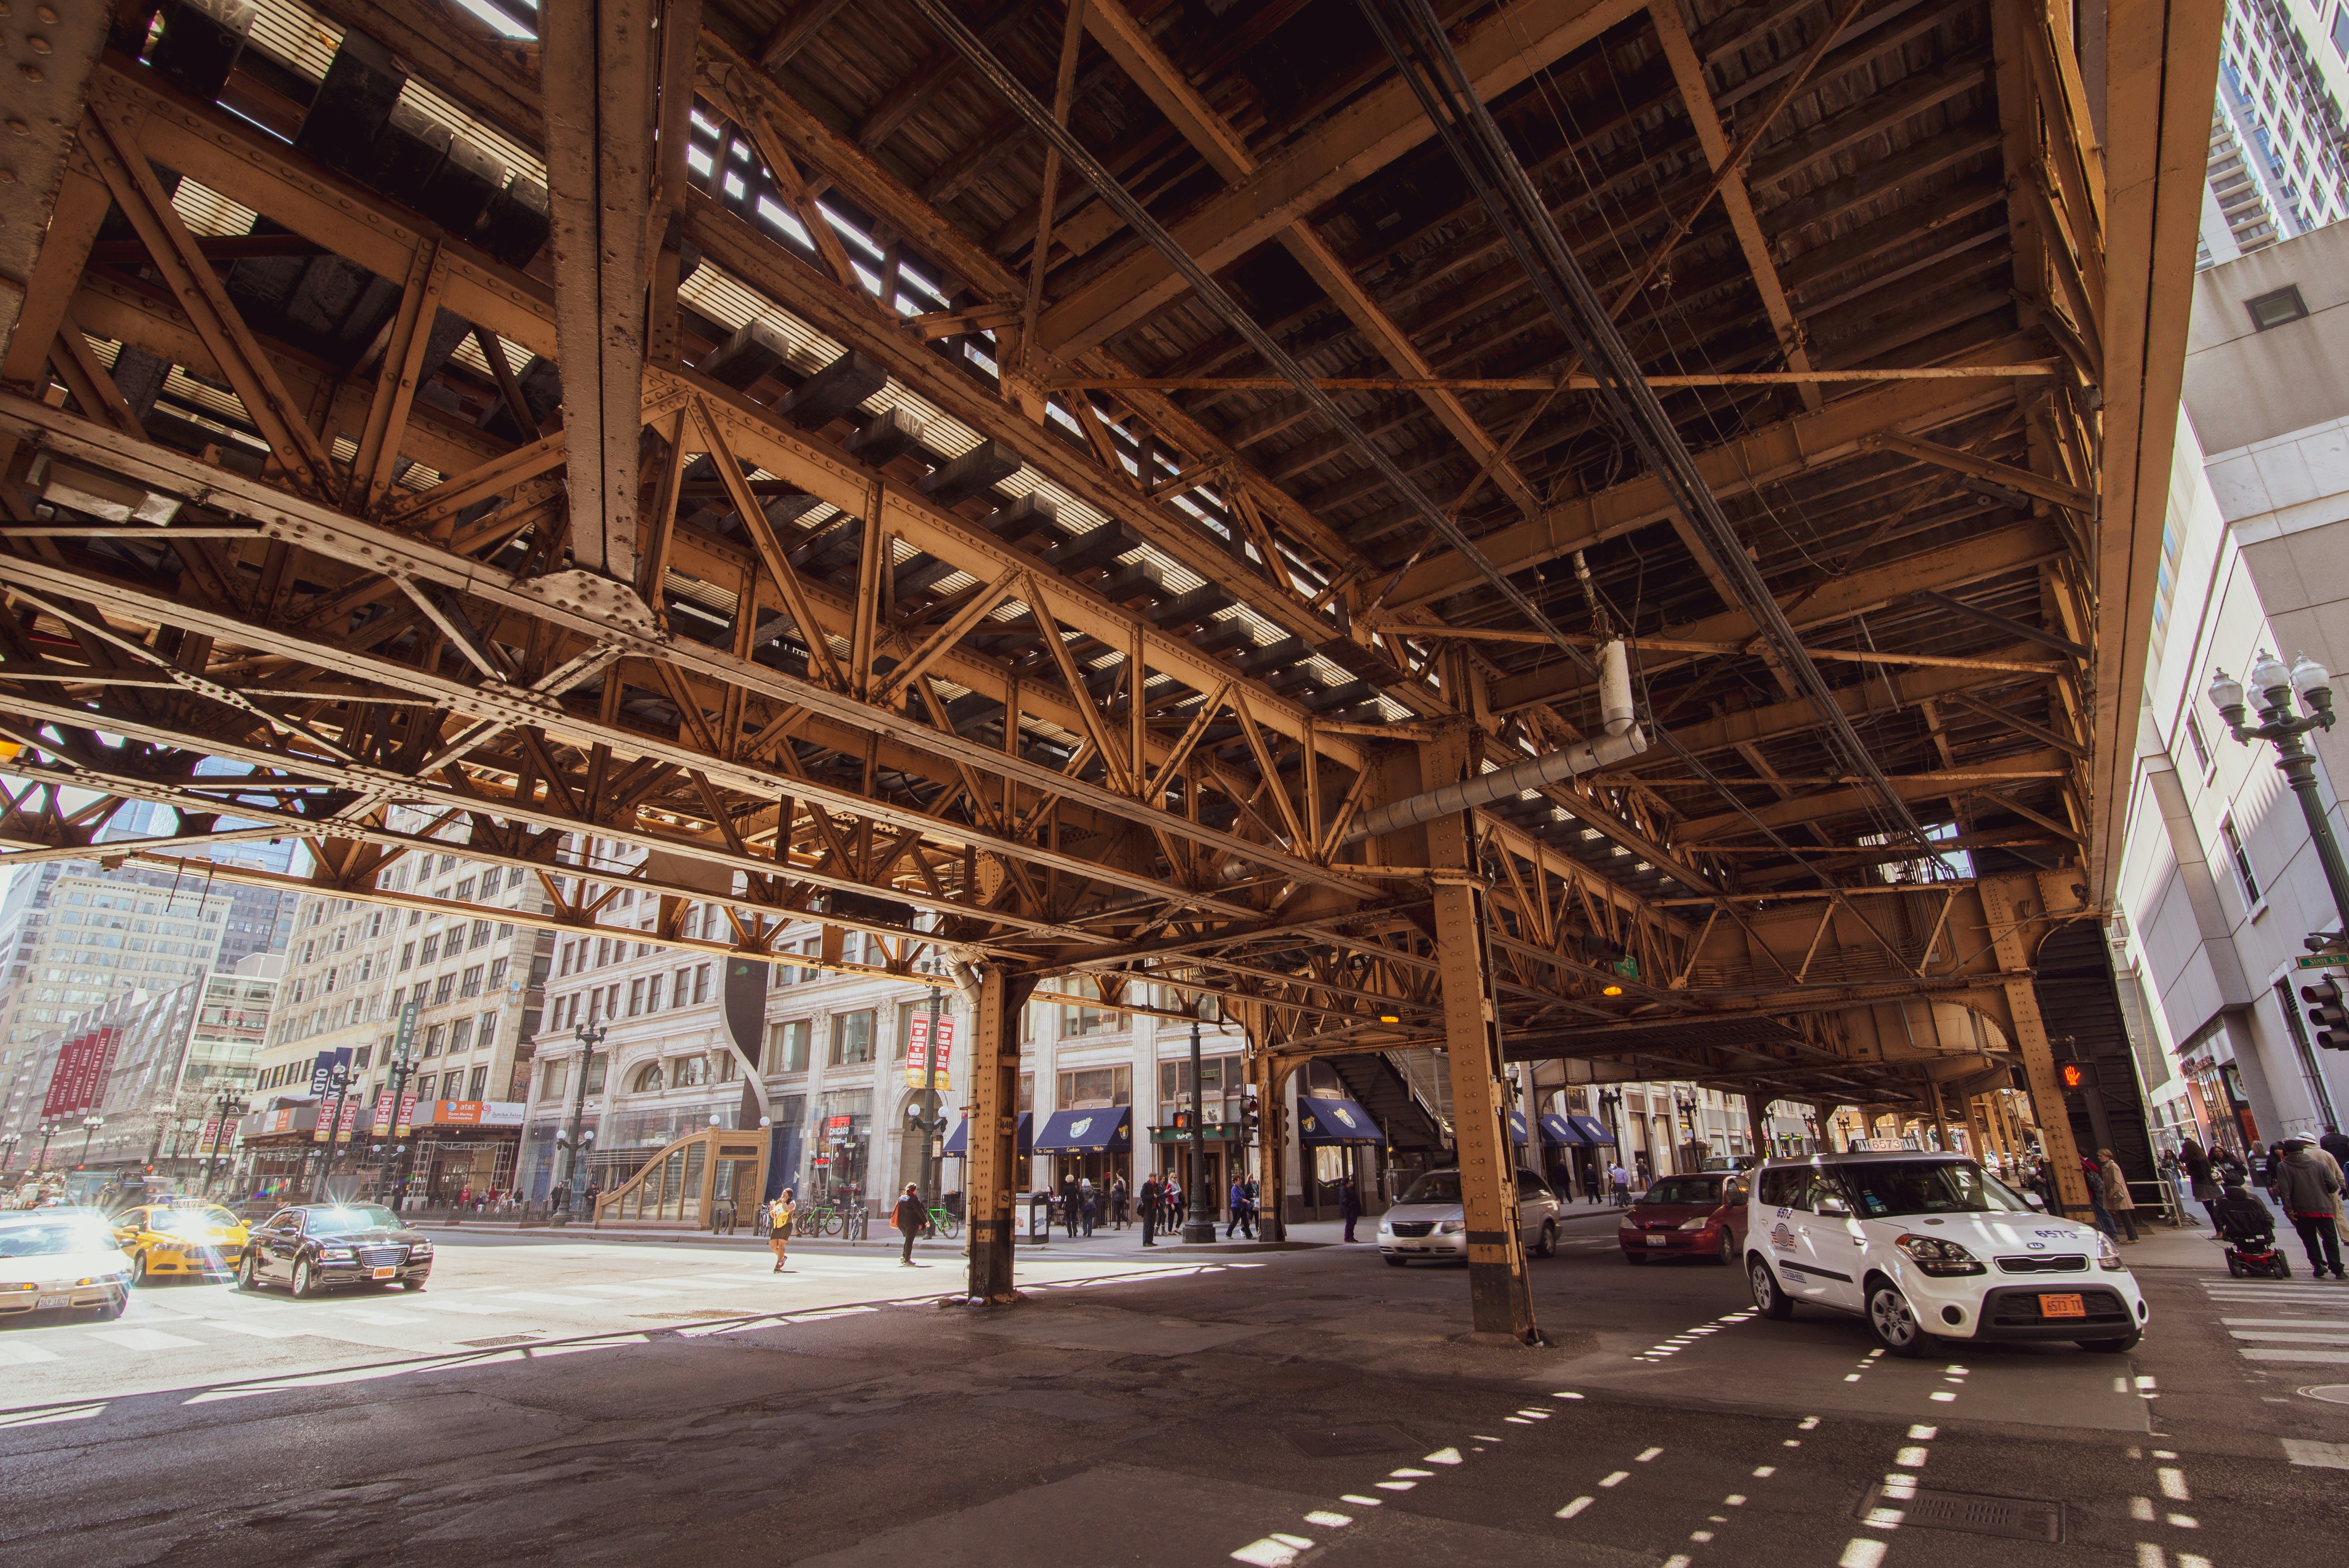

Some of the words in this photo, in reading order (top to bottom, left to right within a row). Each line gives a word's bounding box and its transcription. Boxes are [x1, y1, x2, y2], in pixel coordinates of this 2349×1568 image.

[403, 1008, 414, 1038] GENE
[84, 1081, 94, 1098] SHOPS
[98, 1037, 106, 1053] STATE
[394, 1042, 407, 1088] SISEL
[46, 1085, 57, 1108] SHOPPING
[56, 1059, 65, 1075] DINING
[58, 1089, 67, 1105] SHOPS
[71, 1048, 79, 1063] STATE
[70, 1076, 82, 1102] SHOPPING
[81, 1049, 90, 1066] DINING
[313, 1068, 328, 1092] OLD
[829, 1116, 850, 1127] ESPN
[1071, 1117, 1093, 1128] Potbelly
[829, 1127, 849, 1135] CHICAGO
[1856, 1140, 1873, 1151] TAXI
[1872, 1139, 1900, 1149] 6573
[1900, 1139, 1917, 1150] TAXI
[1777, 1208, 1792, 1219] 6573
[2035, 1230, 2078, 1239] 6573
[2047, 1300, 2067, 1311] 6573
[2071, 1300, 2083, 1311] TX
